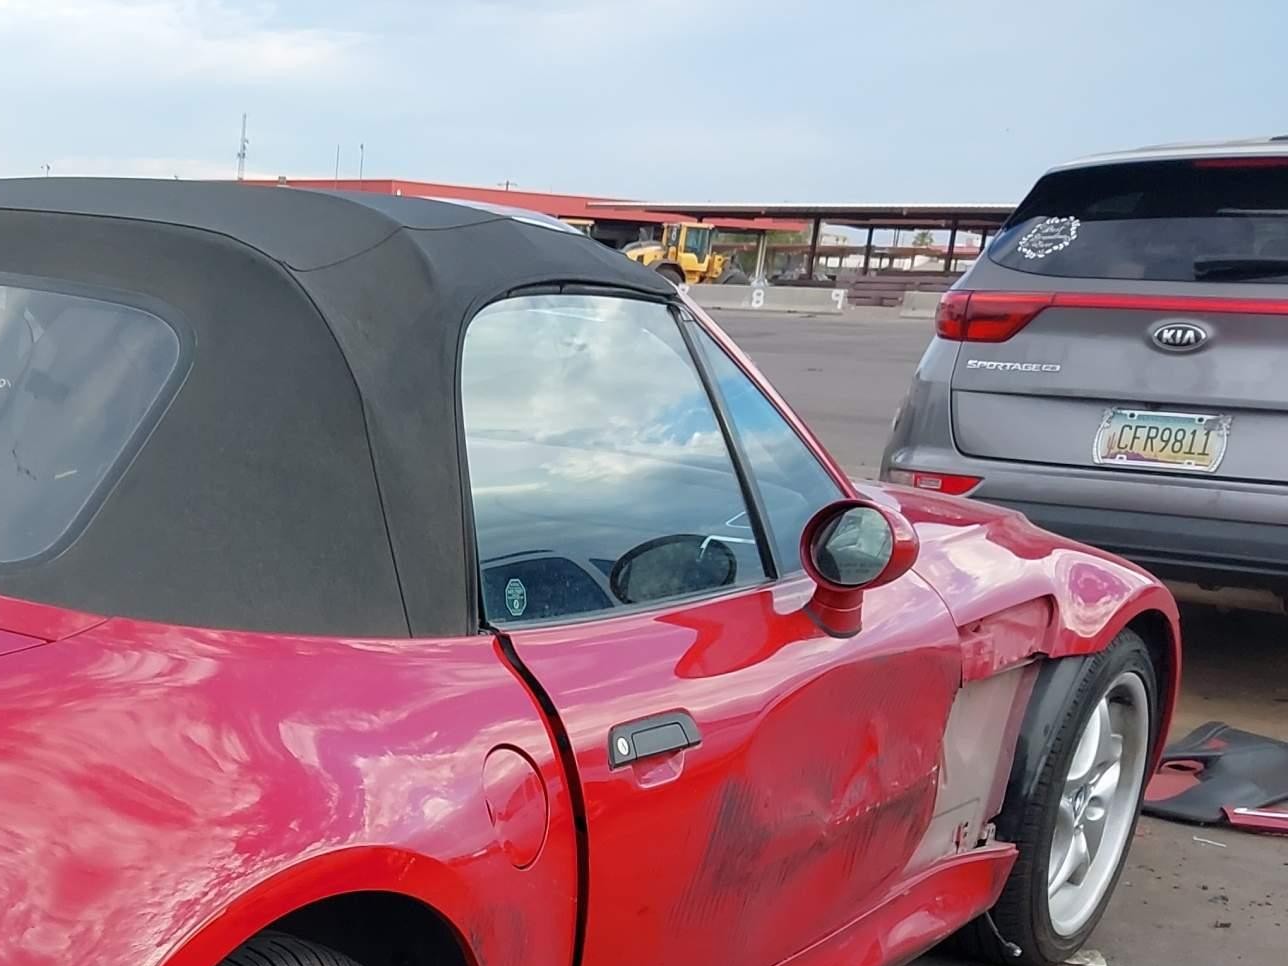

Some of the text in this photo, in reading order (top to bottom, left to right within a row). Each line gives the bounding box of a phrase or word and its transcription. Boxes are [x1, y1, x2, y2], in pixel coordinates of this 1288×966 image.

[751, 289, 764, 308] 8
[831, 289, 845, 310] 9
[1162, 329, 1195, 344] KIA
[966, 359, 1041, 372] SPORTAGE
[1116, 424, 1211, 456] CFR9811
